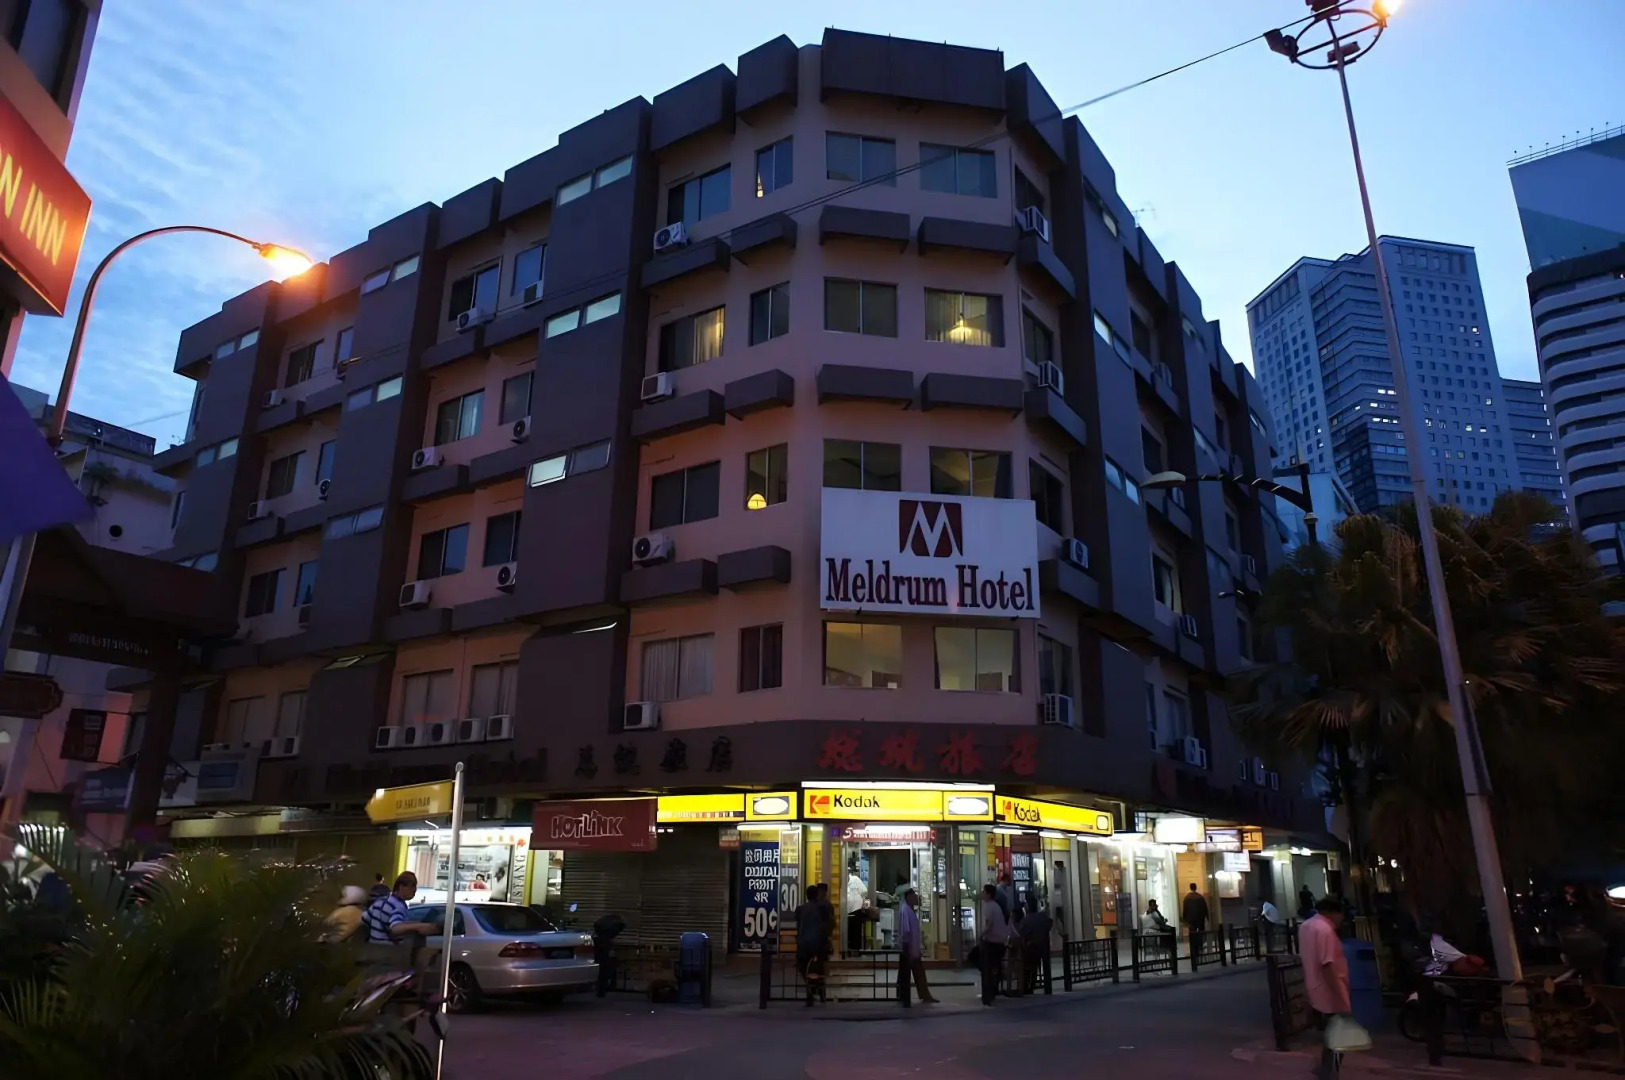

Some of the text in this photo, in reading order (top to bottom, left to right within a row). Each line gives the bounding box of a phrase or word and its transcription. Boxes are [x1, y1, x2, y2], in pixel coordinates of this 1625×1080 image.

[0, 145, 67, 267] N INN
[825, 557, 1035, 611] Meldrum Hotel
[833, 794, 881, 809] Kodak
[1014, 802, 1042, 823] Kodak
